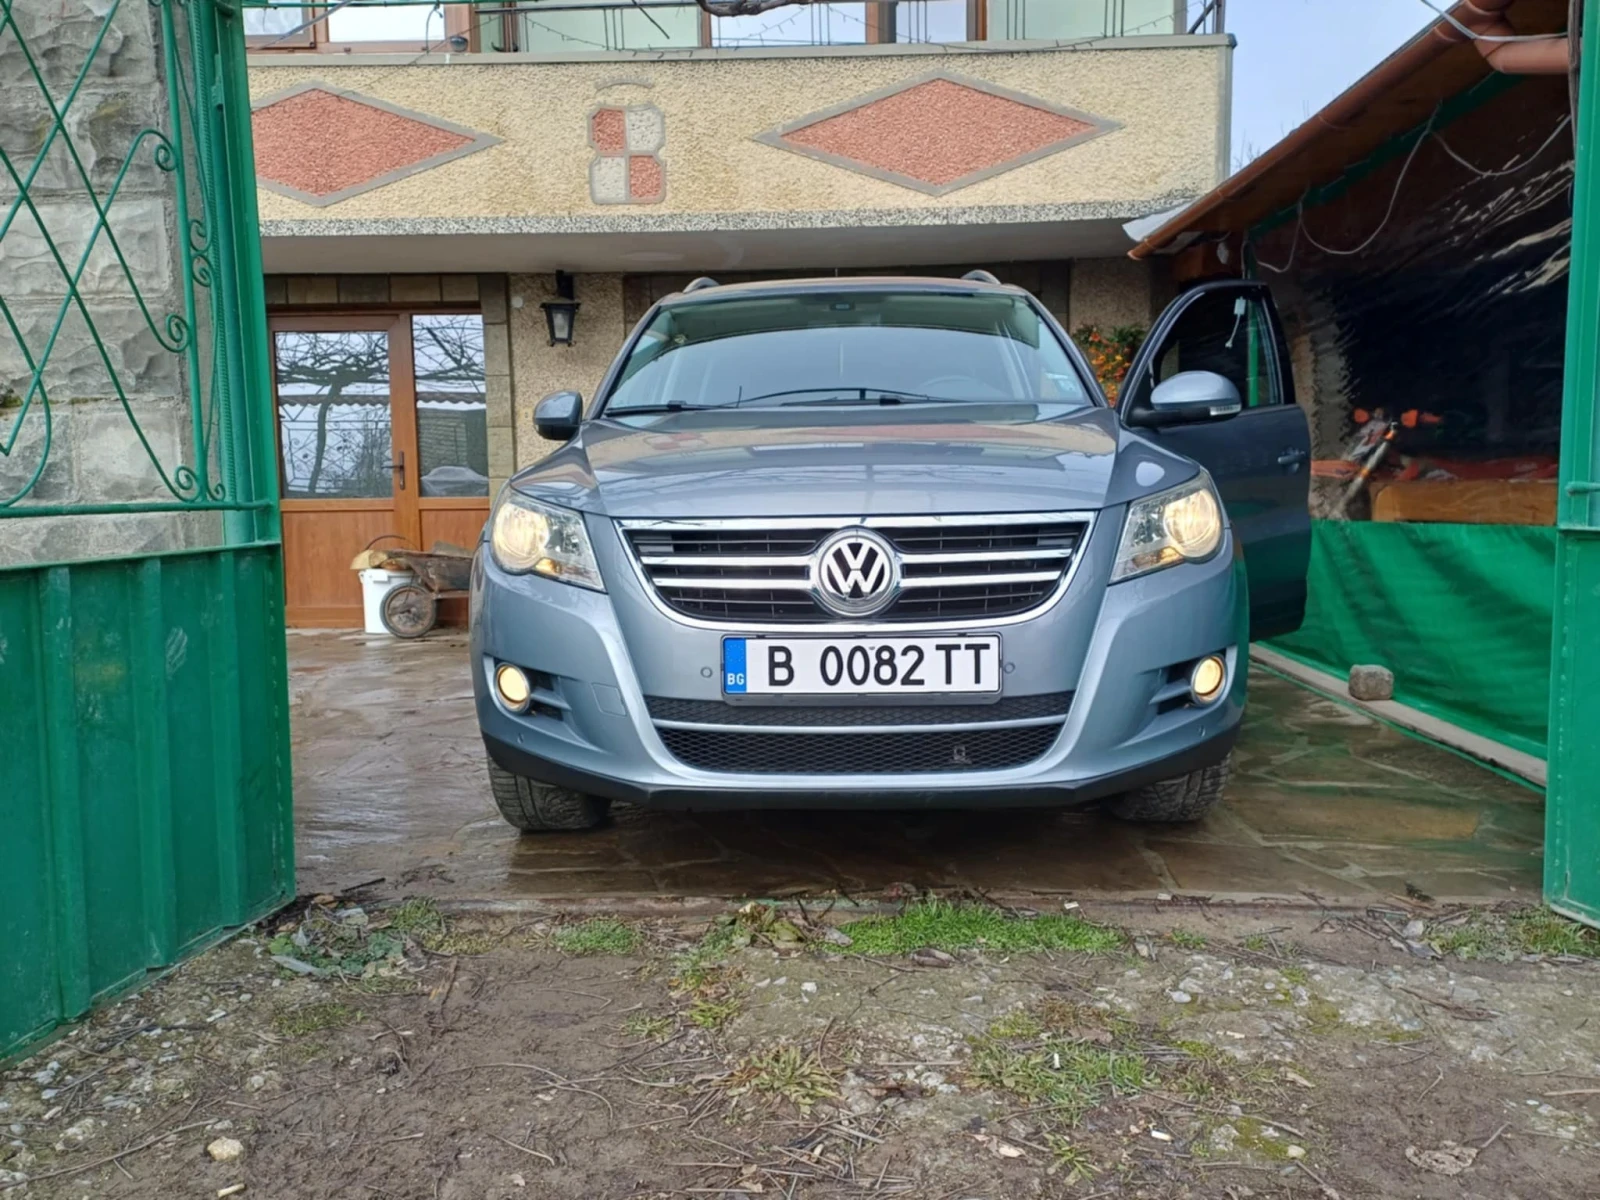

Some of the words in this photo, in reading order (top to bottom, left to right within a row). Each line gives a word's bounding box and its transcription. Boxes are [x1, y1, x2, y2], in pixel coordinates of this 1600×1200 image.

[822, 537, 890, 600] VW
[727, 673, 745, 685] BG
[768, 645, 794, 687] B
[820, 645, 925, 686] 0082
